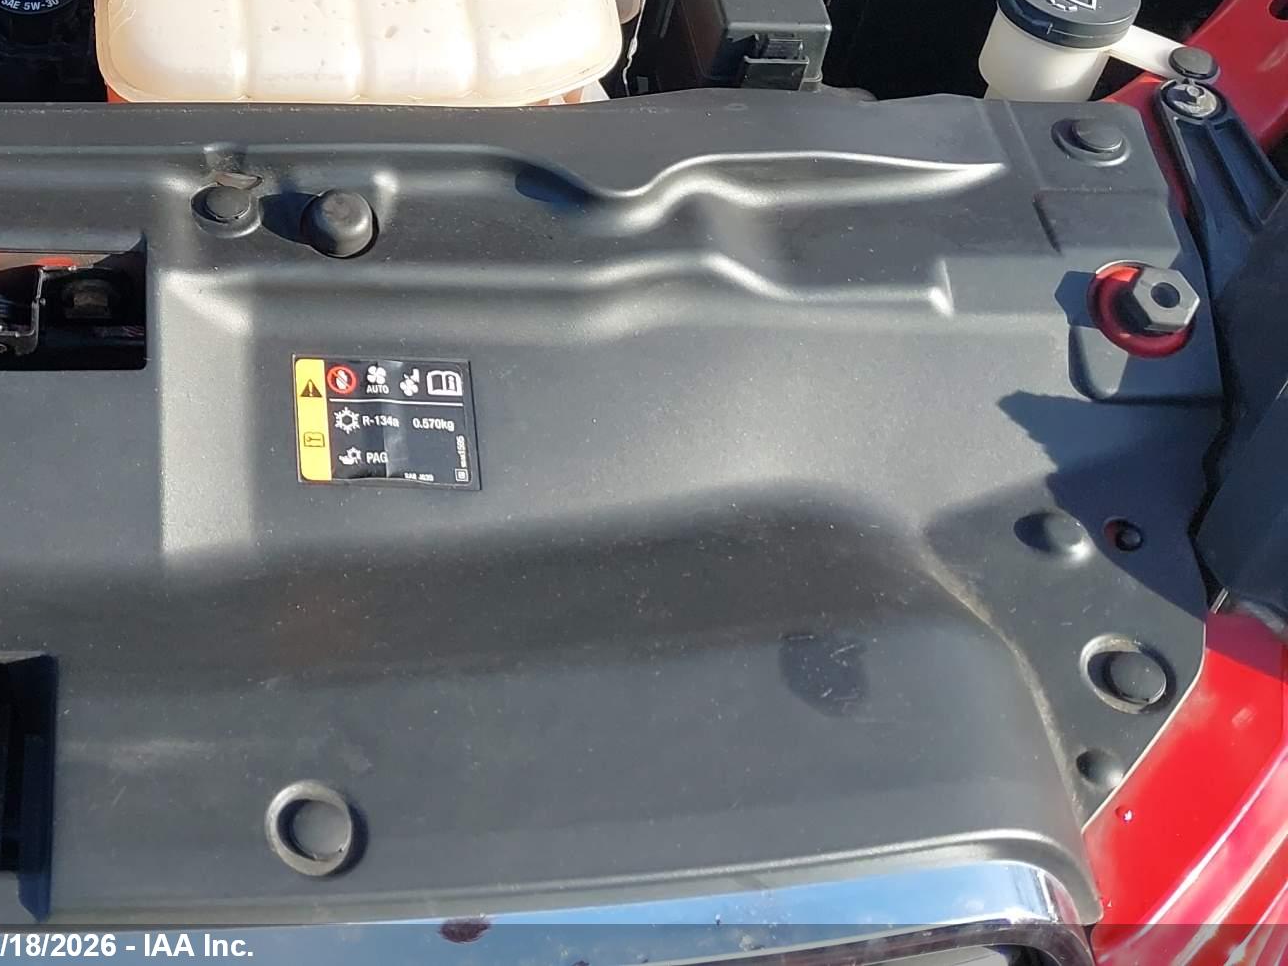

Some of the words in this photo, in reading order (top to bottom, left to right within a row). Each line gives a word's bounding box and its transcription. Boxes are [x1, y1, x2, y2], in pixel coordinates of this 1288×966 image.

[365, 384, 390, 395] AUTO
[361, 415, 400, 428] R-134a
[412, 417, 455, 432] 0.570kg
[365, 451, 389, 465] PAG
